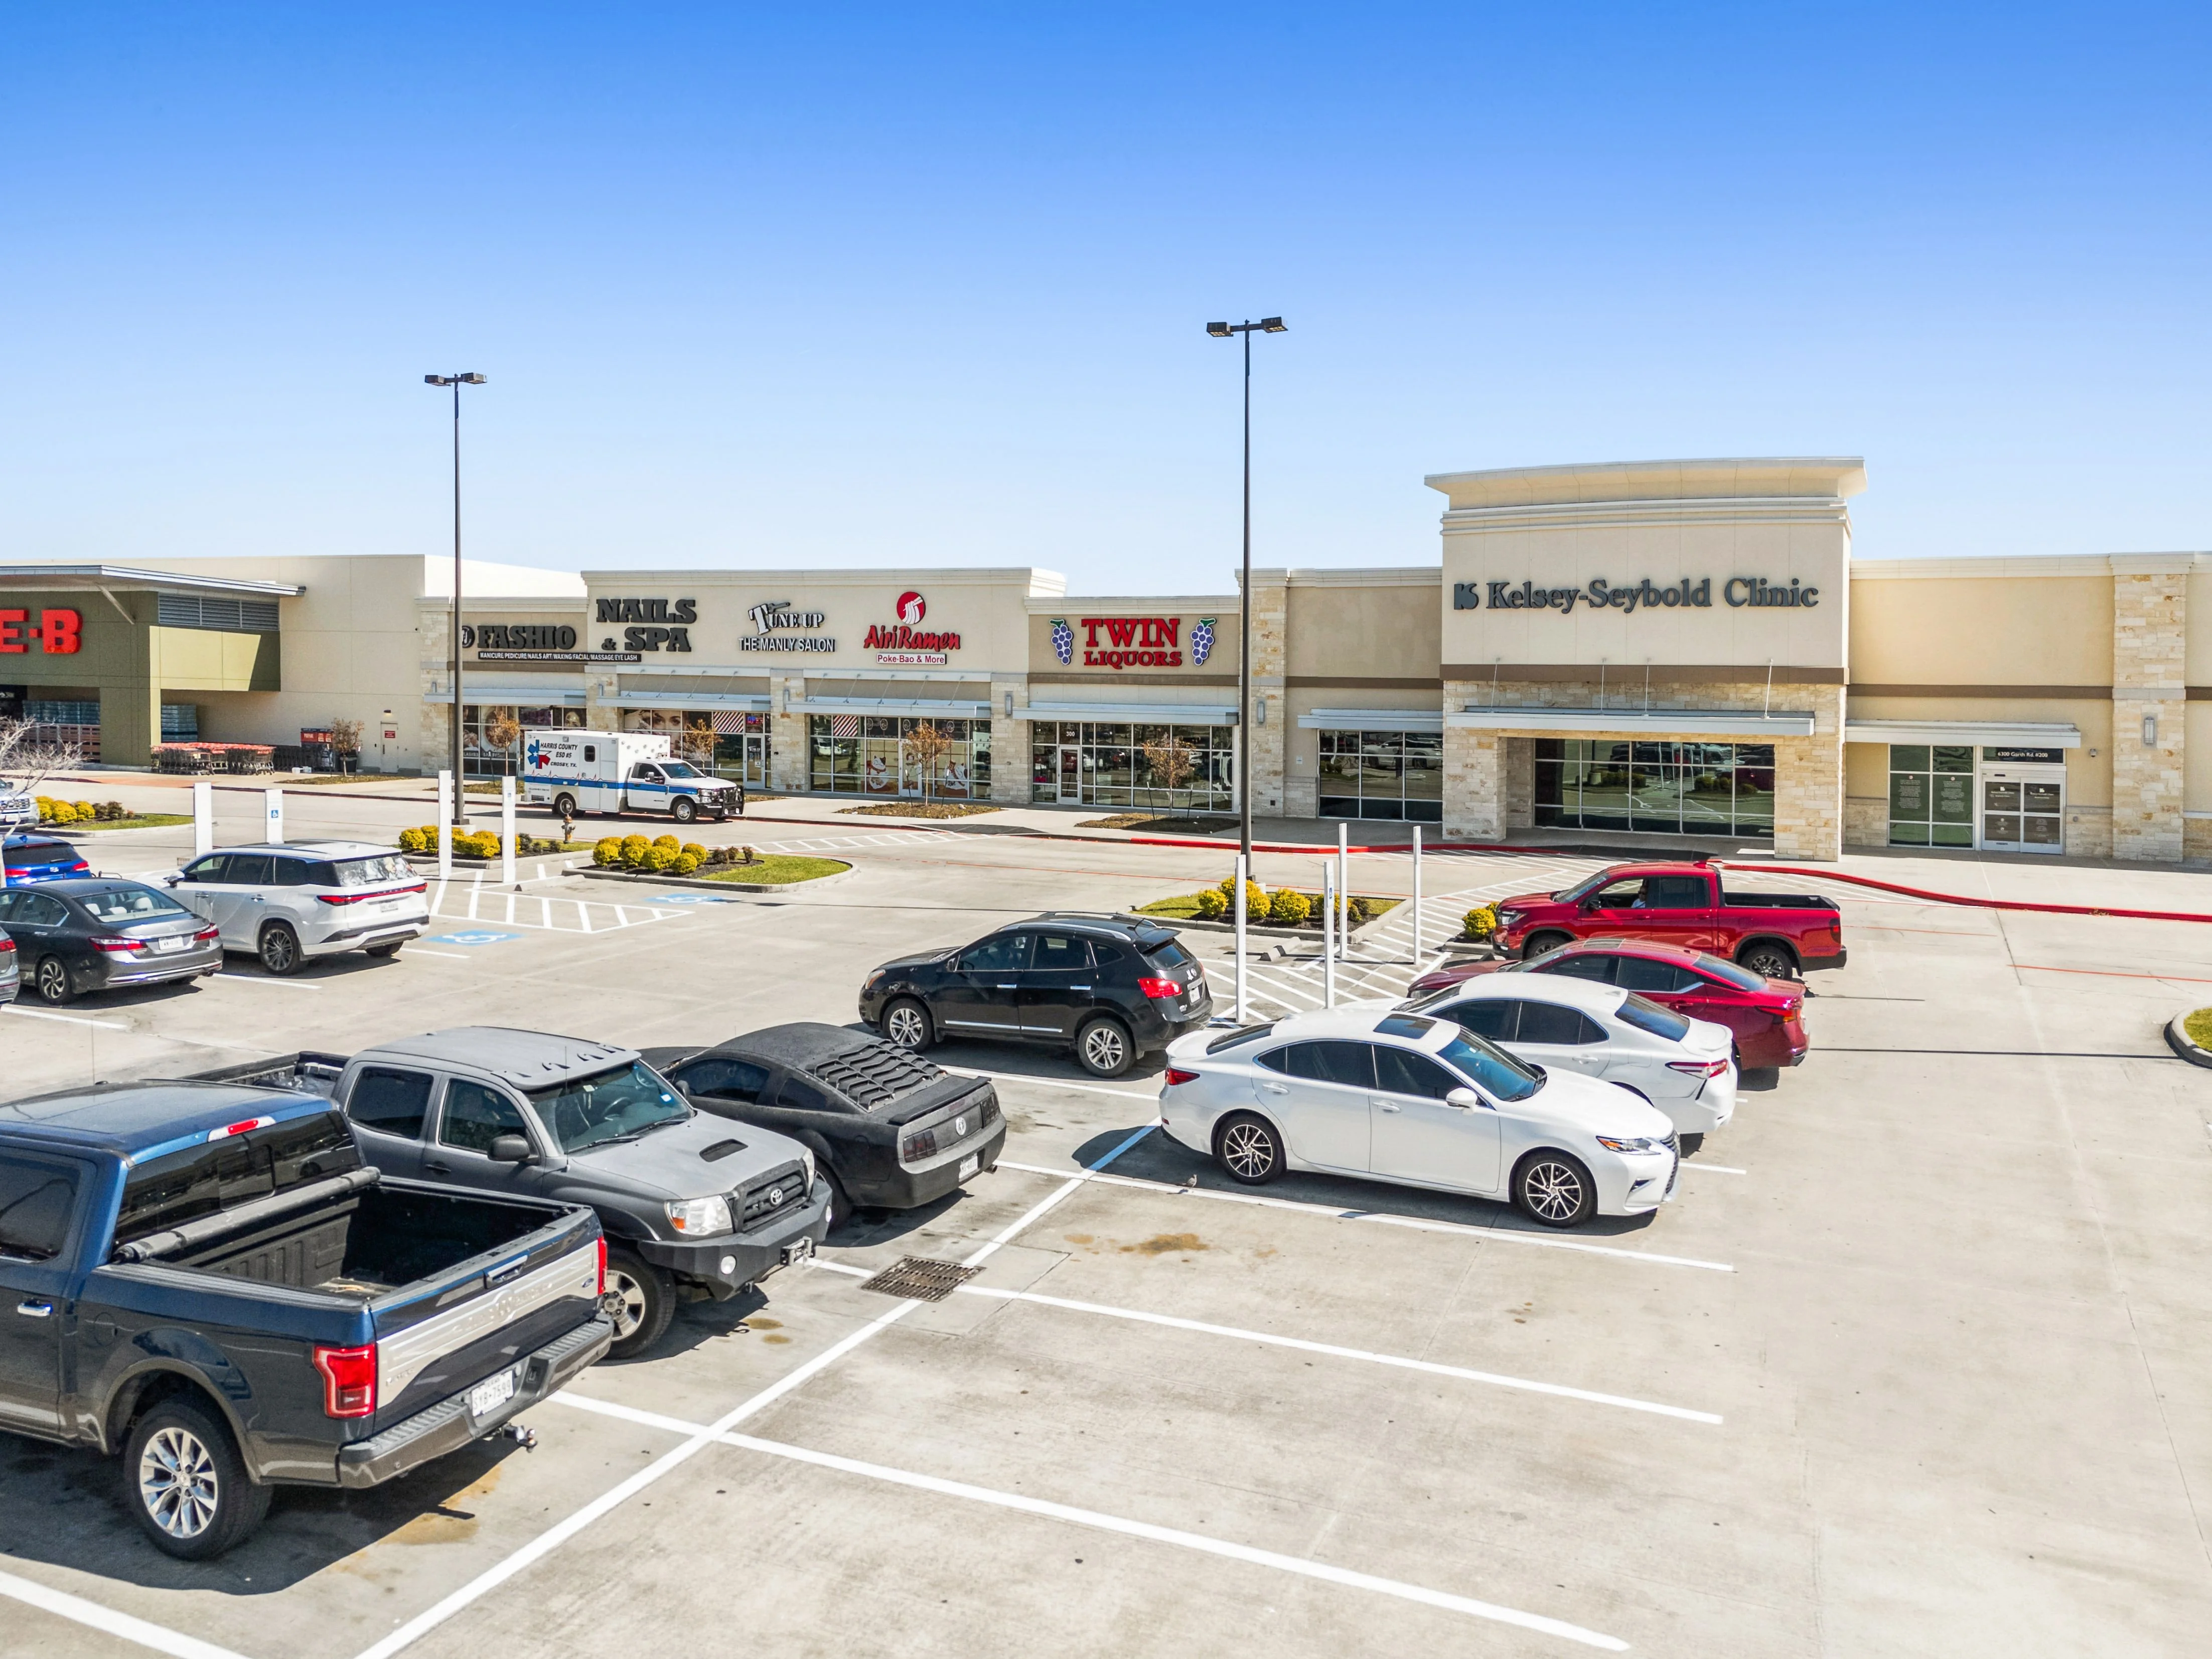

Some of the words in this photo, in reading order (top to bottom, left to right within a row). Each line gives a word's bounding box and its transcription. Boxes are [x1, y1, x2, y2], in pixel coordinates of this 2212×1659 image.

[1486, 578, 1712, 614] Kelsey-Seybold
[1724, 578, 1819, 607] Clinic
[596, 599, 697, 624] NAILS
[802, 614, 825, 628] UP
[477, 626, 576, 650] FASHIO
[601, 638, 617, 651] &
[624, 627, 692, 652] SPA
[738, 638, 761, 651] THE
[761, 638, 797, 652] MANLY
[798, 639, 835, 652] SALON
[1081, 619, 1181, 648] TWIN
[1084, 651, 1183, 670] LIQUORS
